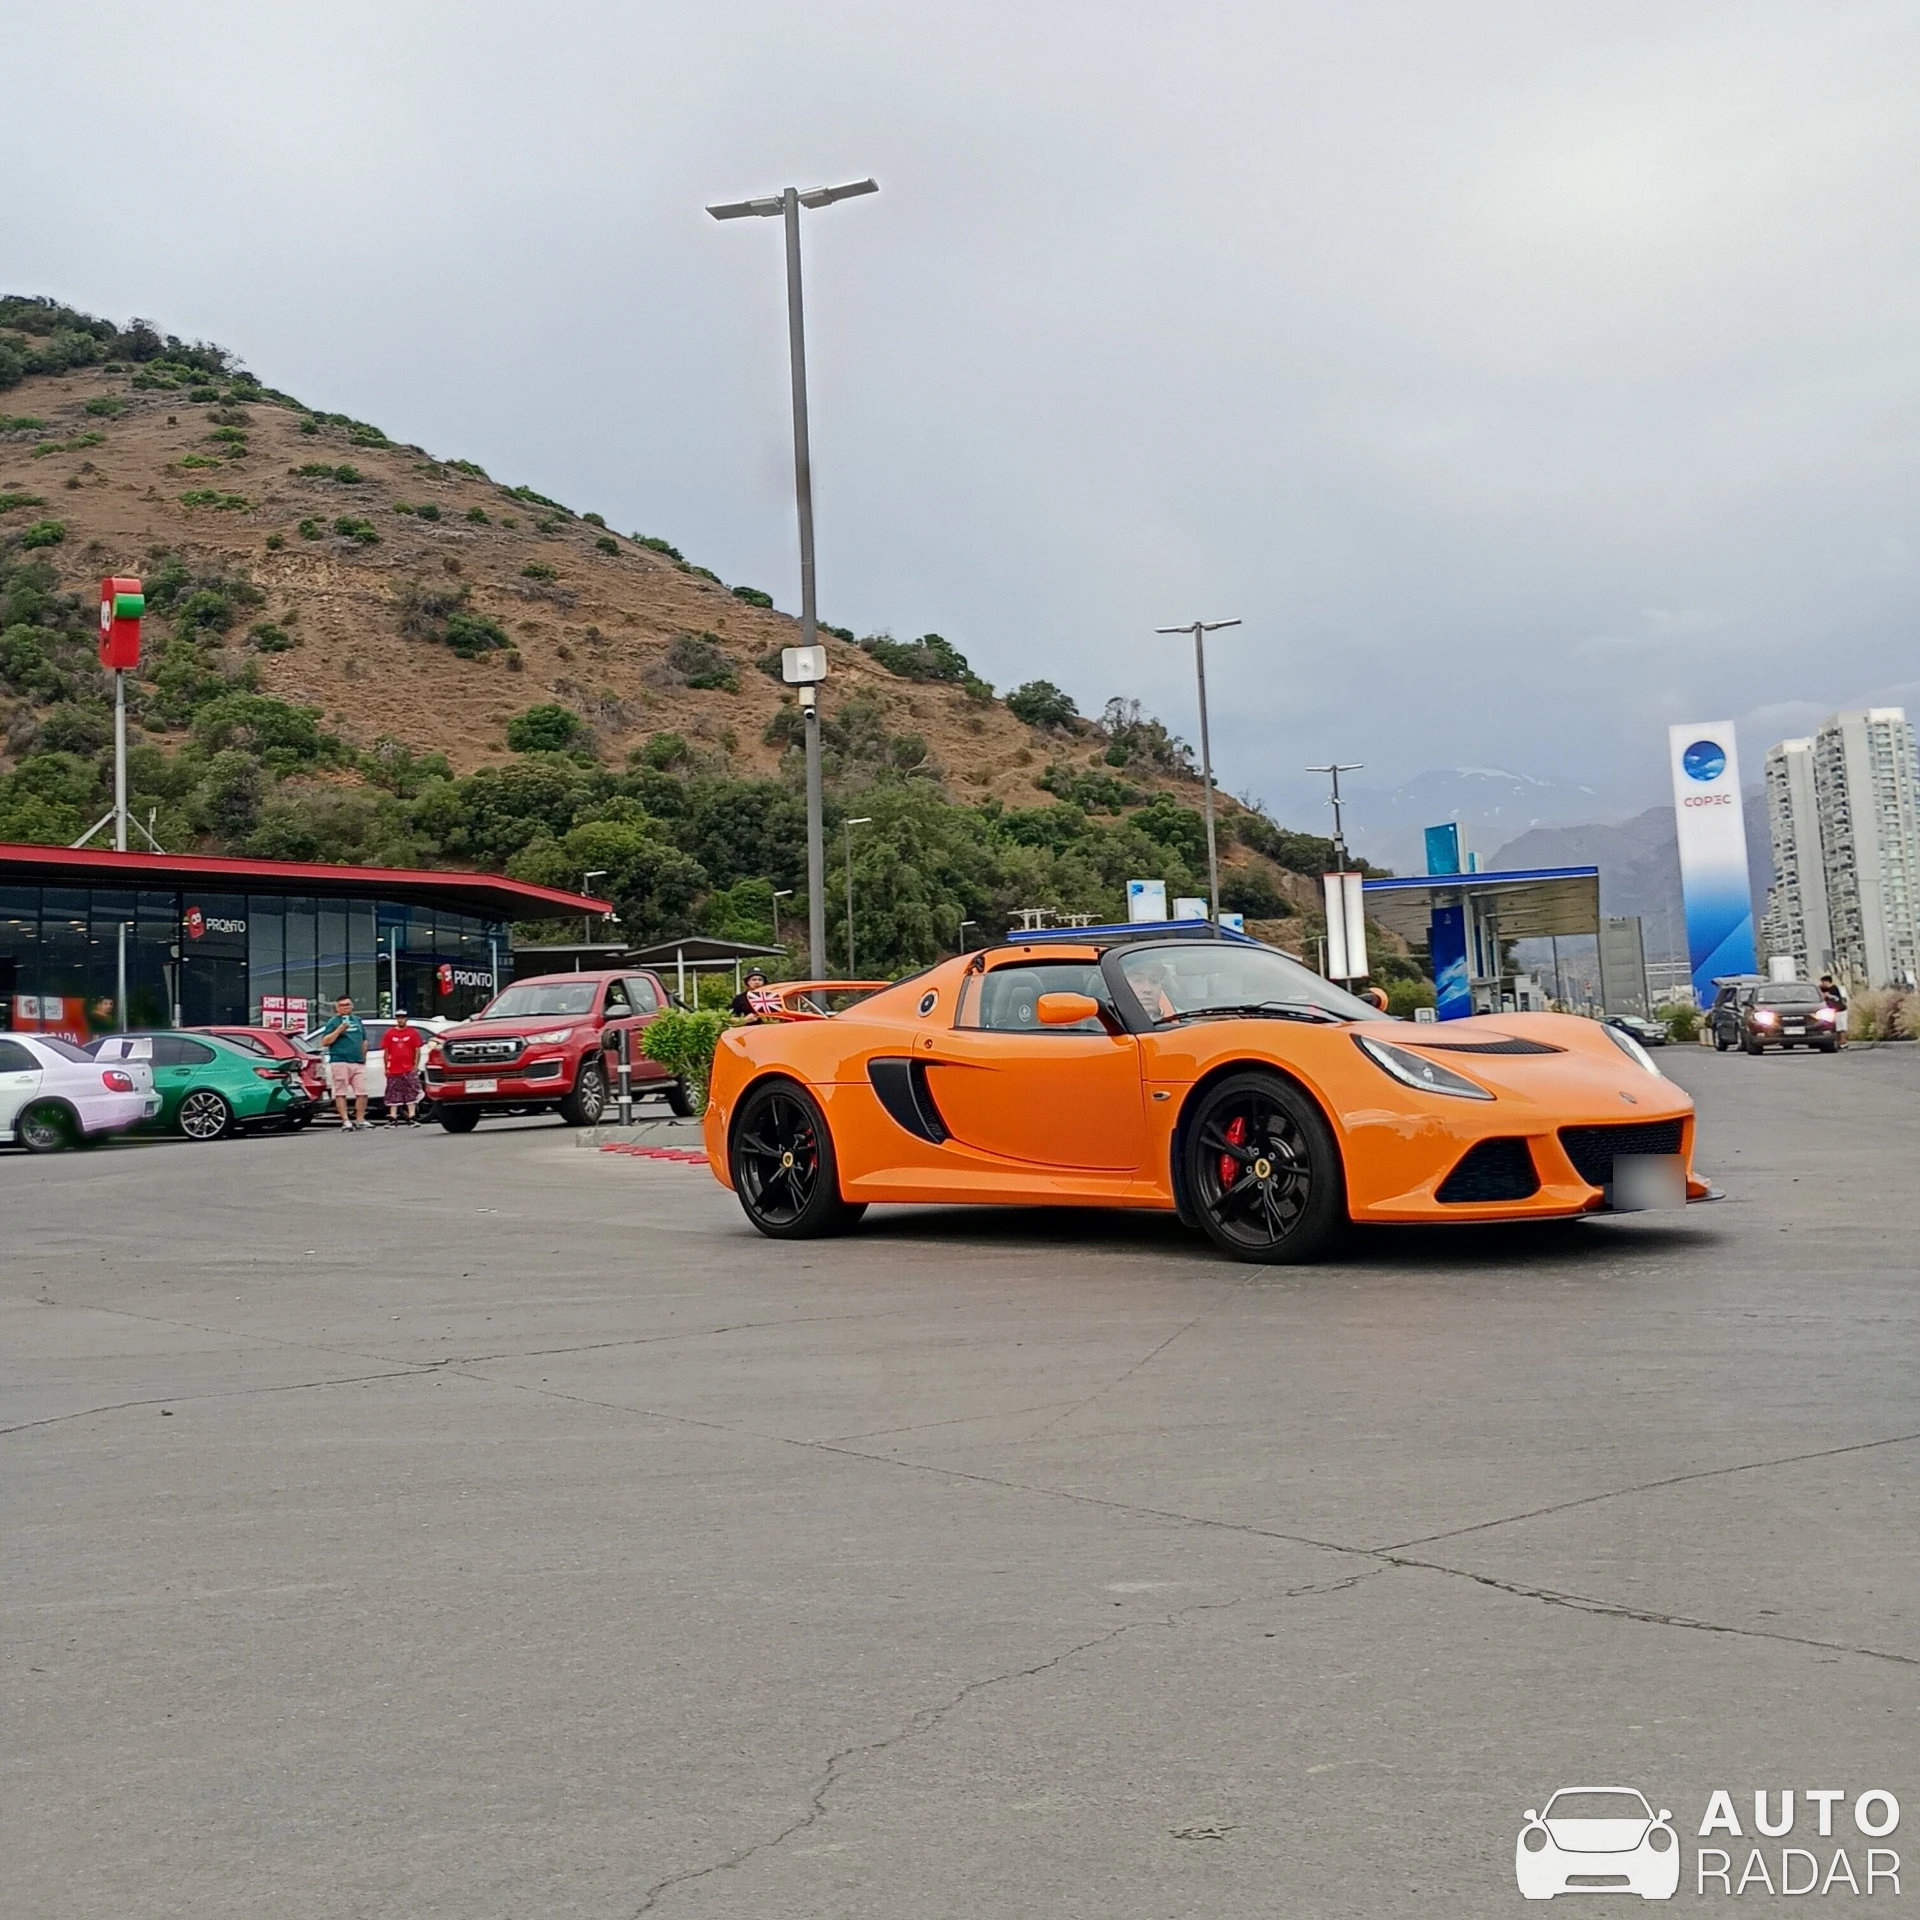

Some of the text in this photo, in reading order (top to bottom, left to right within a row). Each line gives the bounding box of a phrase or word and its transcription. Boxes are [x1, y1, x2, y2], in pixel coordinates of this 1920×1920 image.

[1684, 795, 1732, 807] COPEC
[206, 918, 246, 933] PRONTO
[454, 970, 493, 987] PRONTO
